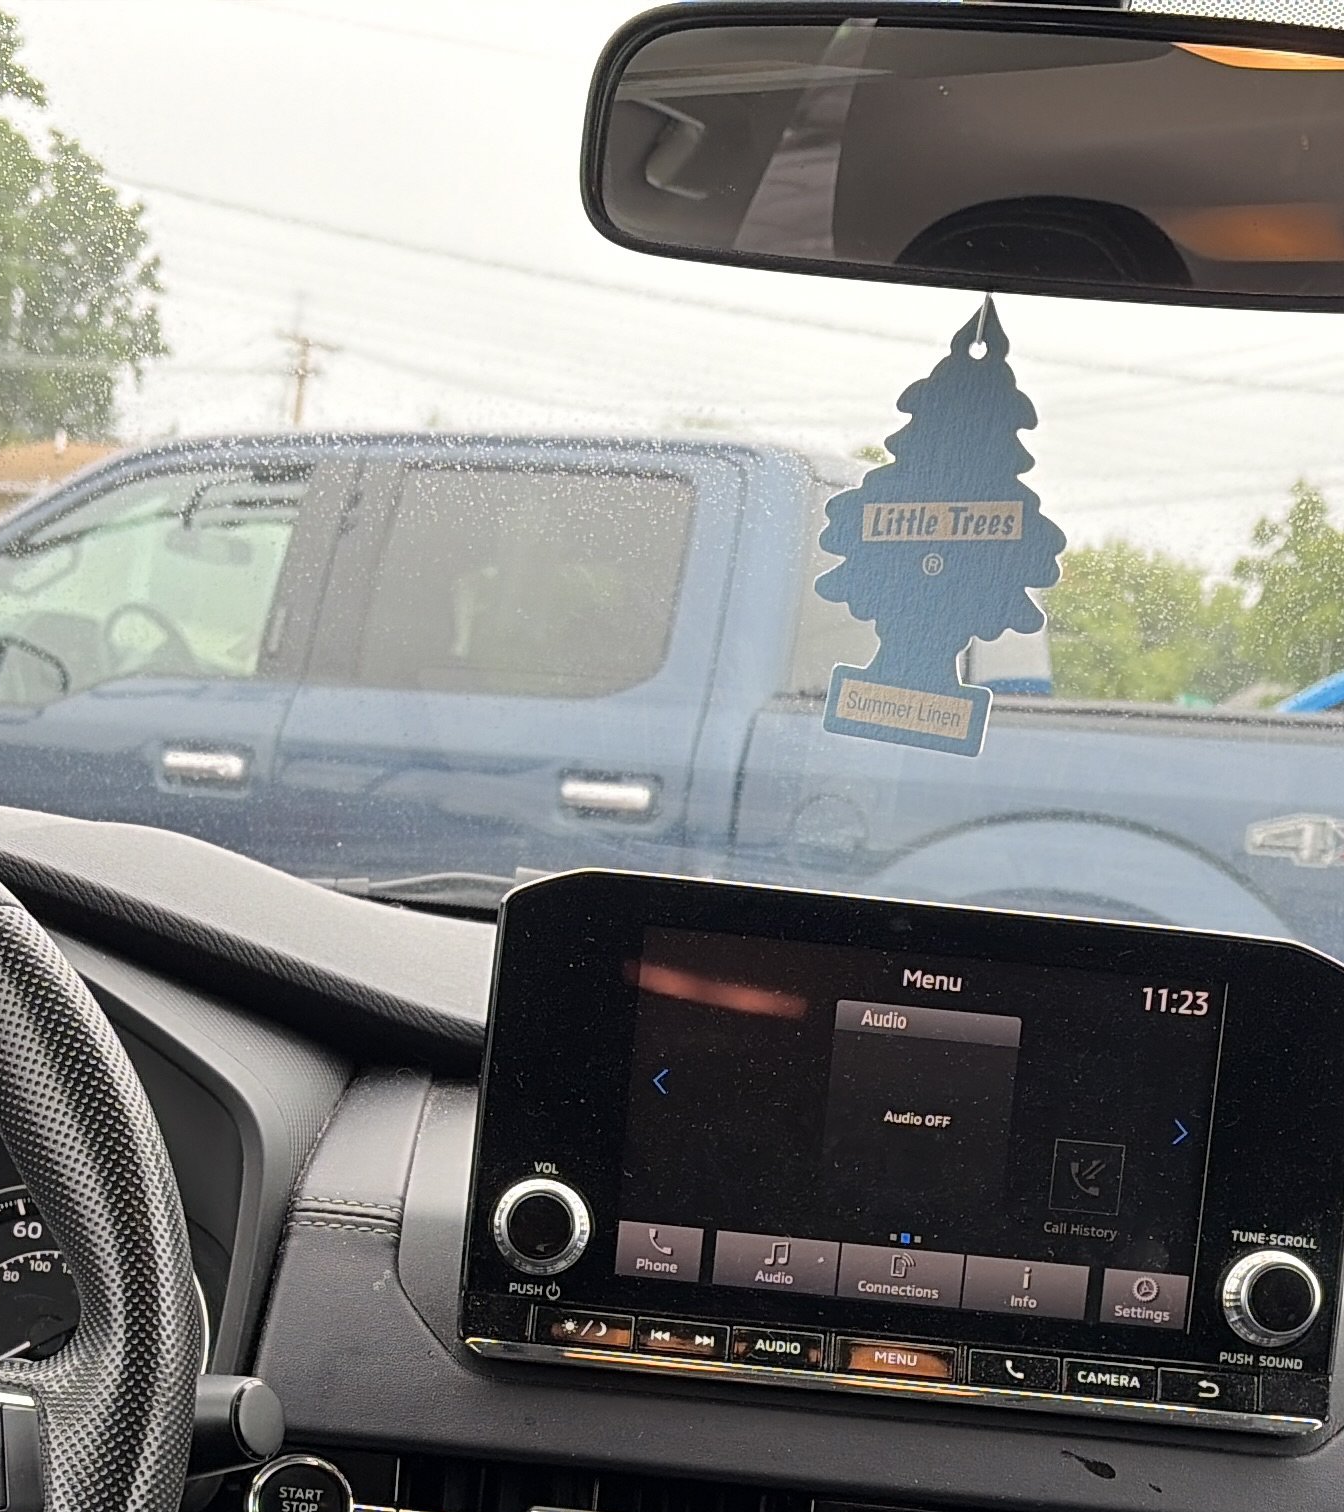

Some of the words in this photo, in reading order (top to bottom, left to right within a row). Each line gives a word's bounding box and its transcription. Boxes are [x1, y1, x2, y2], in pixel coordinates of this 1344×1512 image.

[870, 507, 939, 537] Little
[949, 506, 1015, 536] Trees
[846, 690, 913, 720] Summer
[918, 705, 961, 727] Linen
[902, 969, 962, 992] Menu
[1142, 987, 1209, 1016] 11:23
[860, 1009, 907, 1030] Audio
[884, 1110, 923, 1127] Audio
[925, 1114, 951, 1128] OFF
[534, 1161, 559, 1175] VOL
[12, 1220, 43, 1240] 60
[1043, 1221, 1068, 1235] Call
[1070, 1224, 1118, 1241] History
[29, 1259, 52, 1273] 100
[635, 1257, 679, 1274] Phone
[2, 1270, 20, 1283] 80
[754, 1269, 794, 1286] Audio
[509, 1281, 544, 1297] PUSH
[857, 1280, 940, 1300] Connections
[1009, 1294, 1038, 1310] Info
[1113, 1304, 1171, 1323] Settings
[755, 1338, 802, 1355] AUDIO
[873, 1350, 918, 1368] MENU
[1219, 1351, 1253, 1366] PUSH
[1258, 1355, 1303, 1371] SOUND
[1076, 1370, 1141, 1390] CAMERA
[279, 1486, 324, 1501] START
